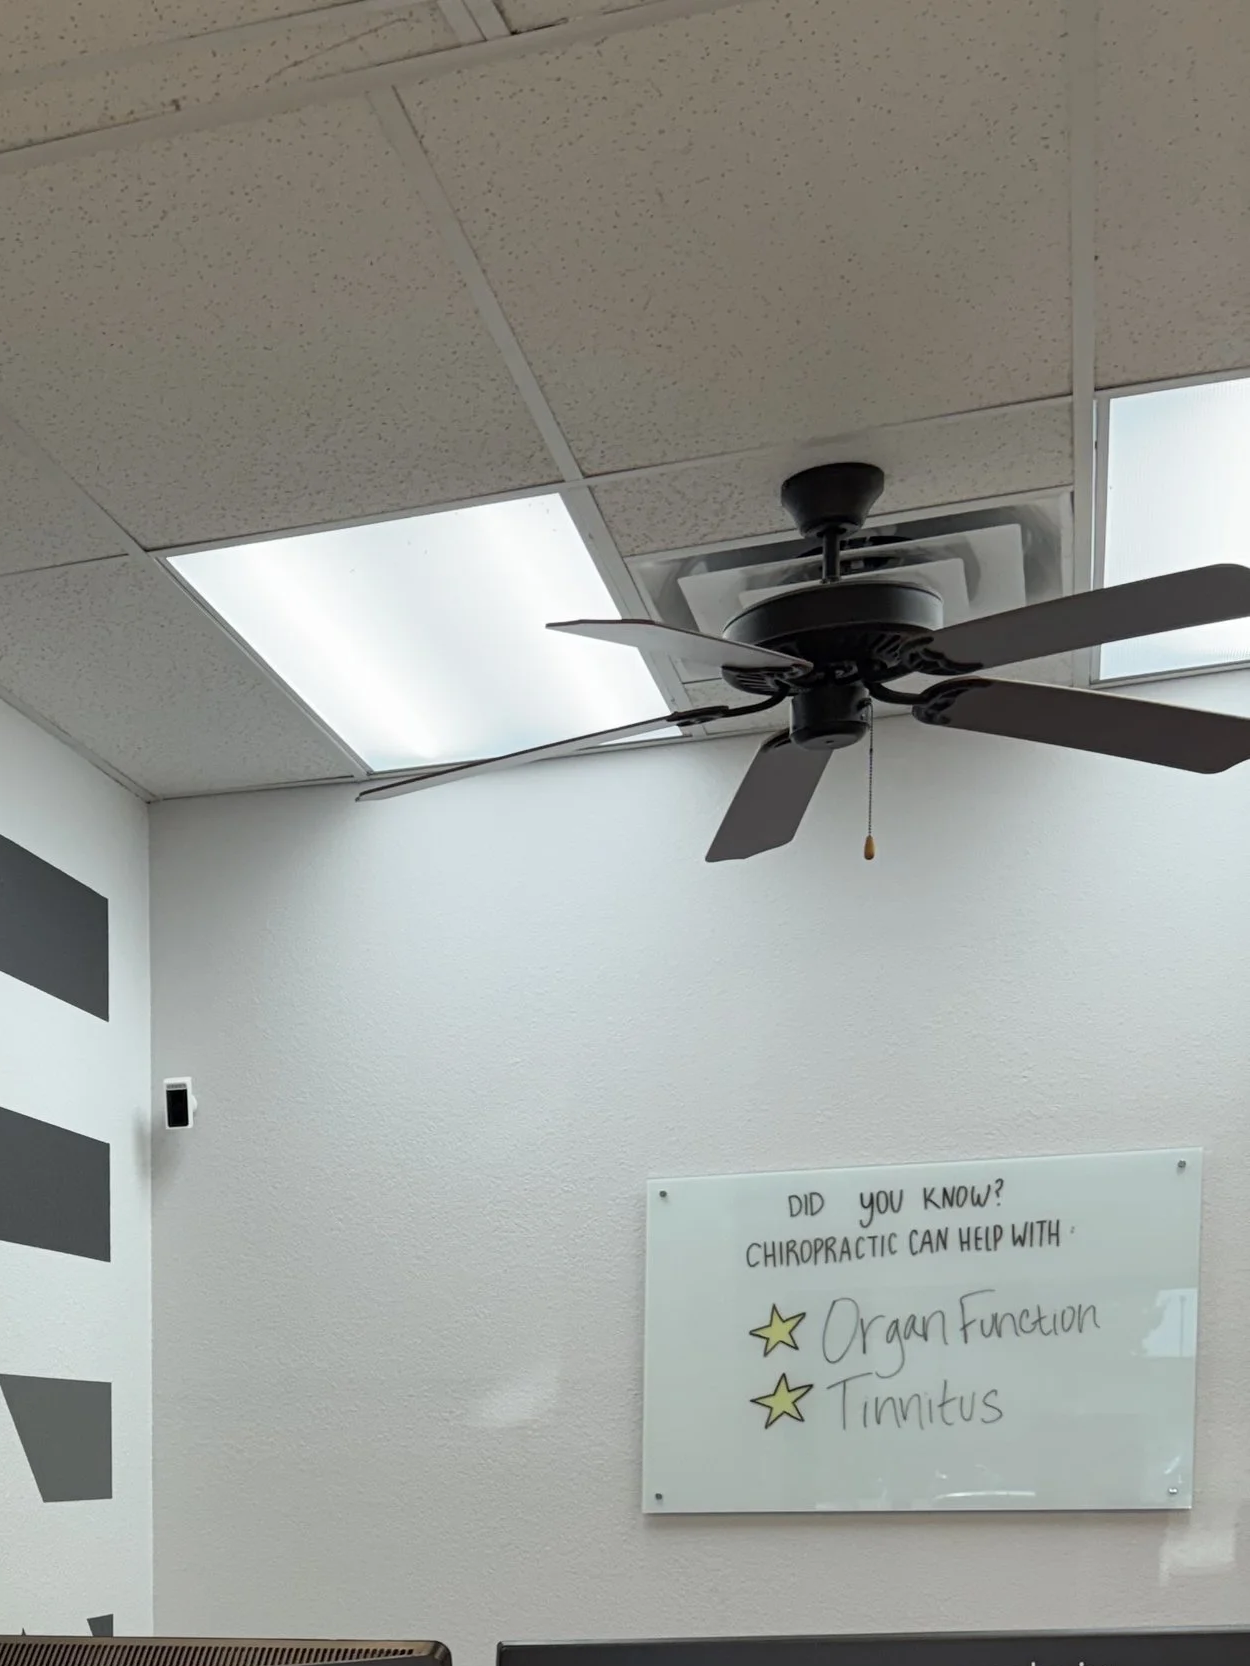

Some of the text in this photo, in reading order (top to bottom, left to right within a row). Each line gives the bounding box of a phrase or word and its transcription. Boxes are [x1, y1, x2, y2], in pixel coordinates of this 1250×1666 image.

[788, 1178, 1005, 1228] DID YOU KNOW?
[745, 1233, 898, 1269] CHIROPRACTIC
[909, 1226, 949, 1257] CAN
[959, 1221, 1004, 1252] HELP
[822, 1289, 1101, 1378] Organ Function
[826, 1372, 1004, 1430] Tinnitus
